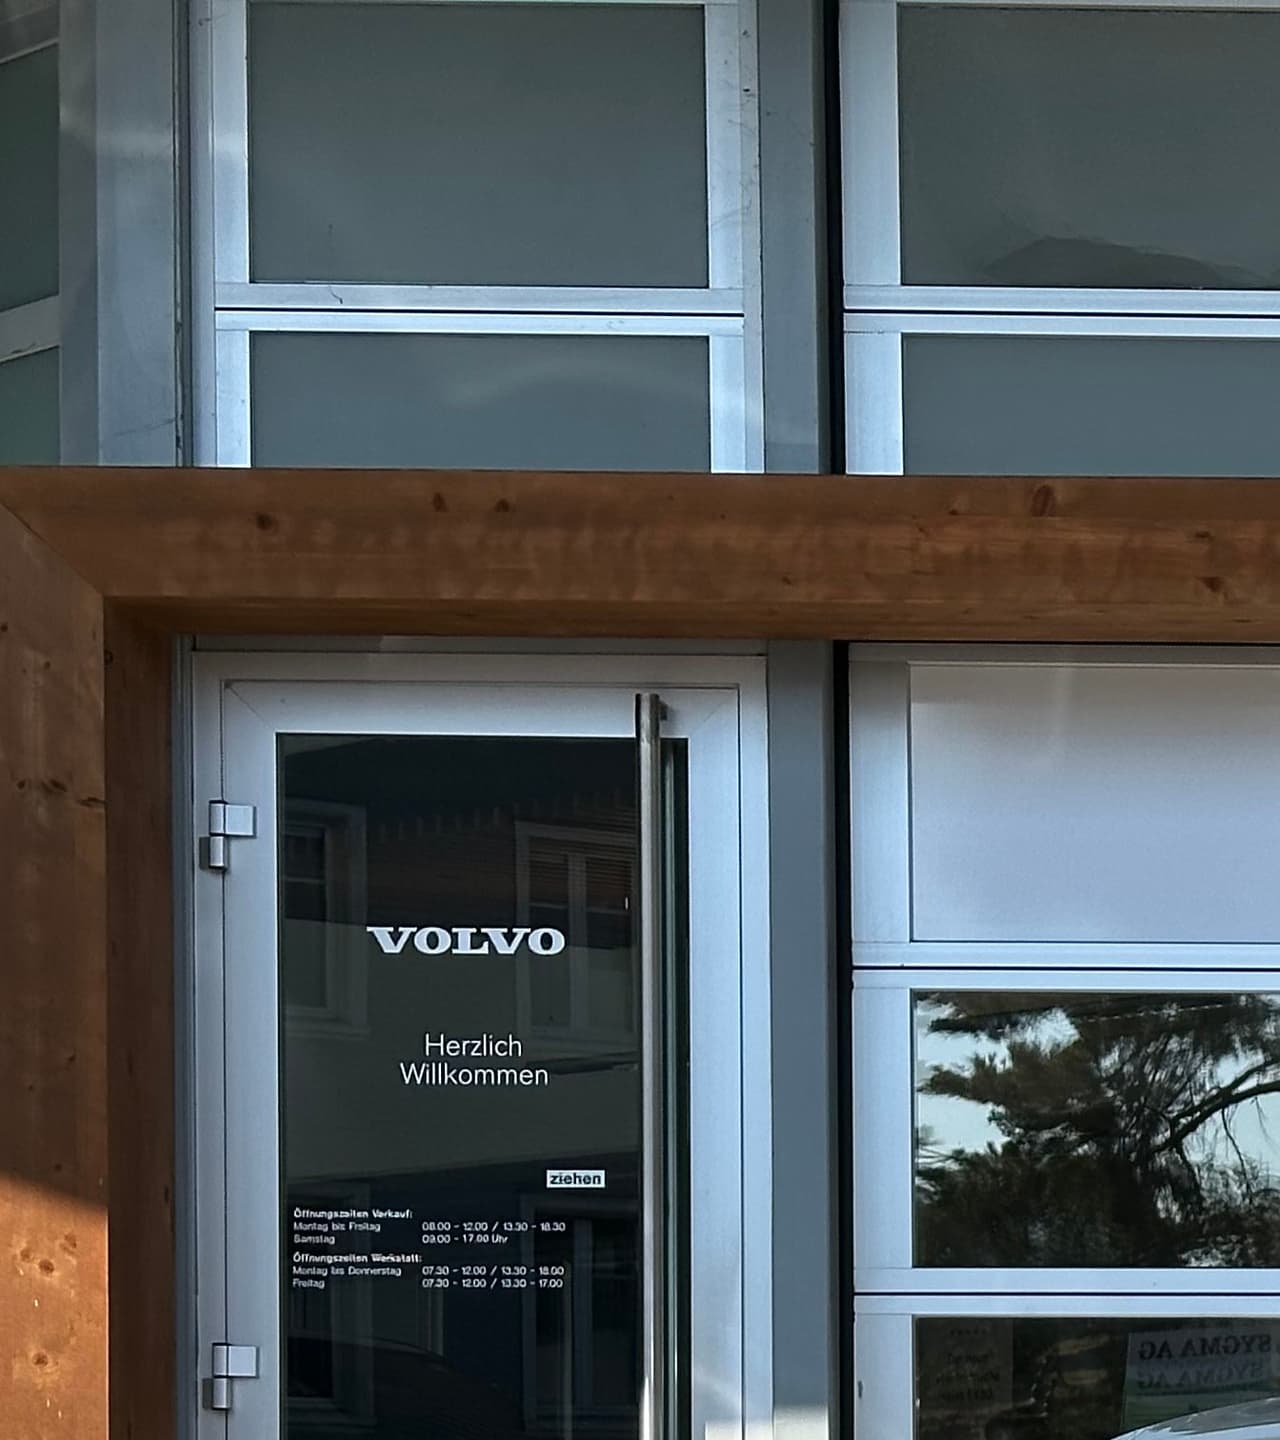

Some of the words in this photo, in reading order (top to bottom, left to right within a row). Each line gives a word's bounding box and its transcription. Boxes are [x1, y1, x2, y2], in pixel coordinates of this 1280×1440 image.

[366, 926, 566, 955] VOLVO
[424, 1033, 523, 1057] Herzlich
[400, 1063, 549, 1086] Willkommen
[549, 1173, 602, 1185] ziehen
